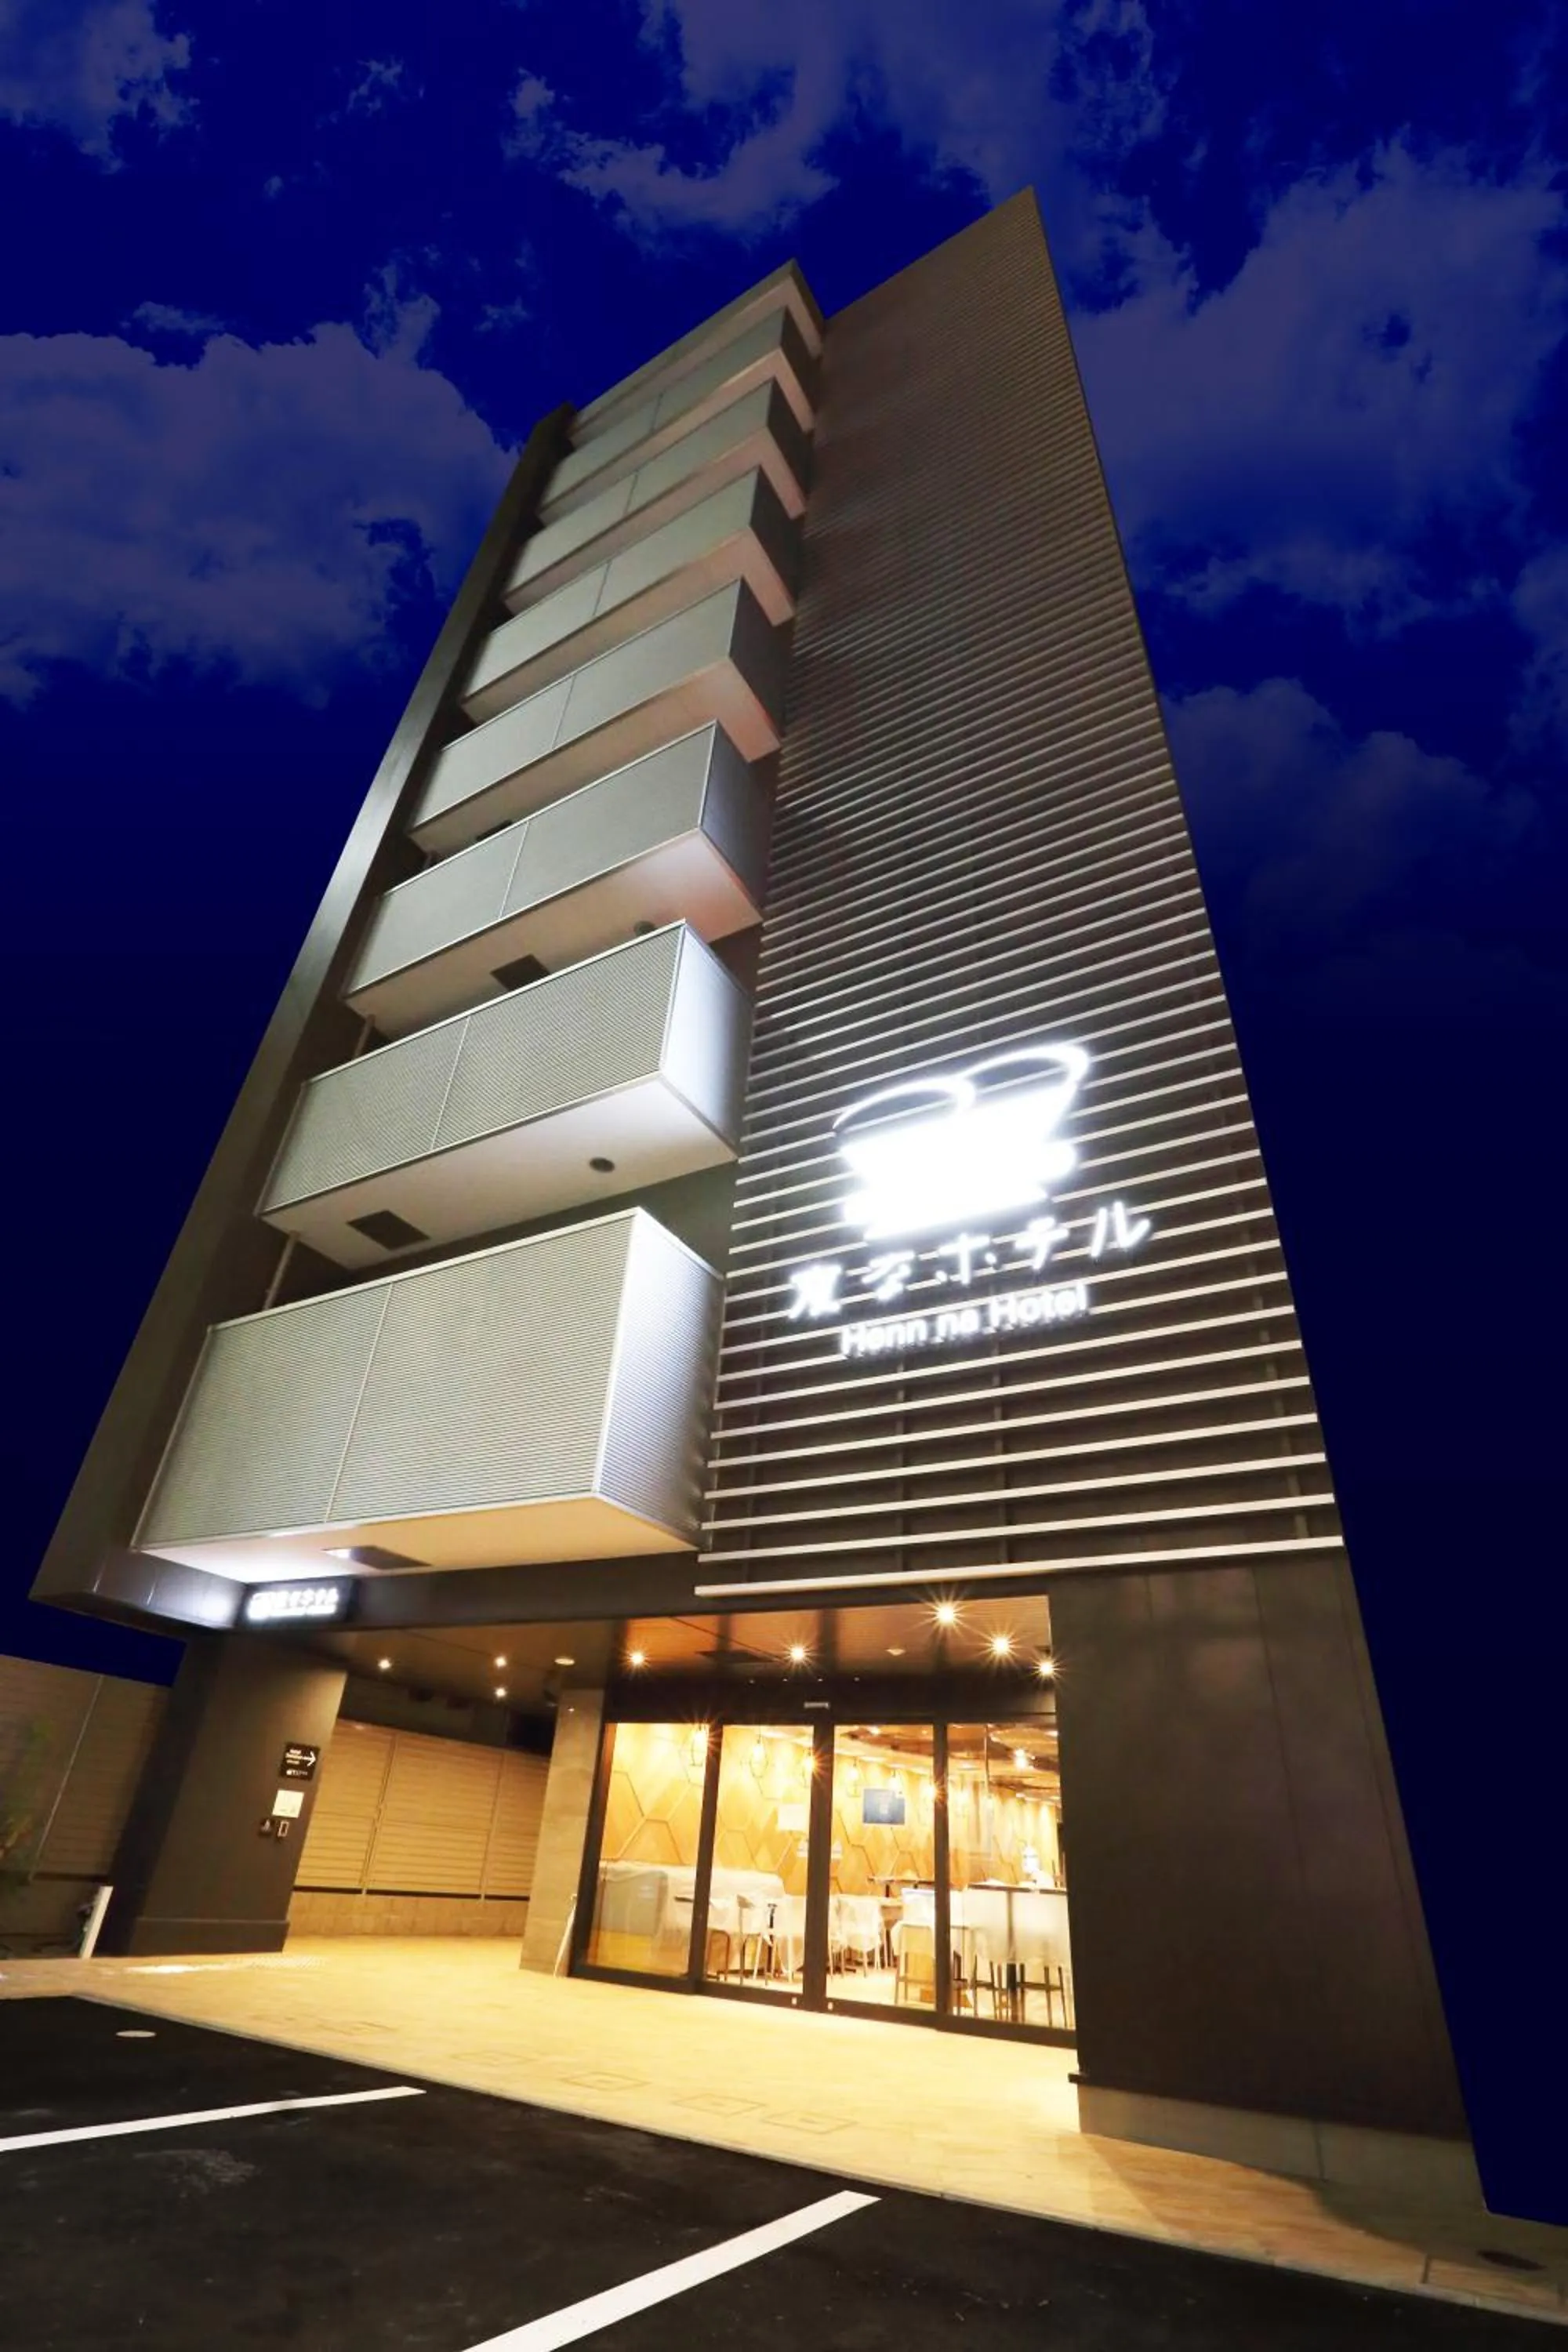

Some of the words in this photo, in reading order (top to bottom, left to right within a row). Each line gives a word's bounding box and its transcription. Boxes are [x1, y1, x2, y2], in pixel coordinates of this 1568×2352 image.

[840, 1318, 927, 1356] Henn
[937, 1308, 980, 1341] na
[989, 1281, 1088, 1330] Hotel
